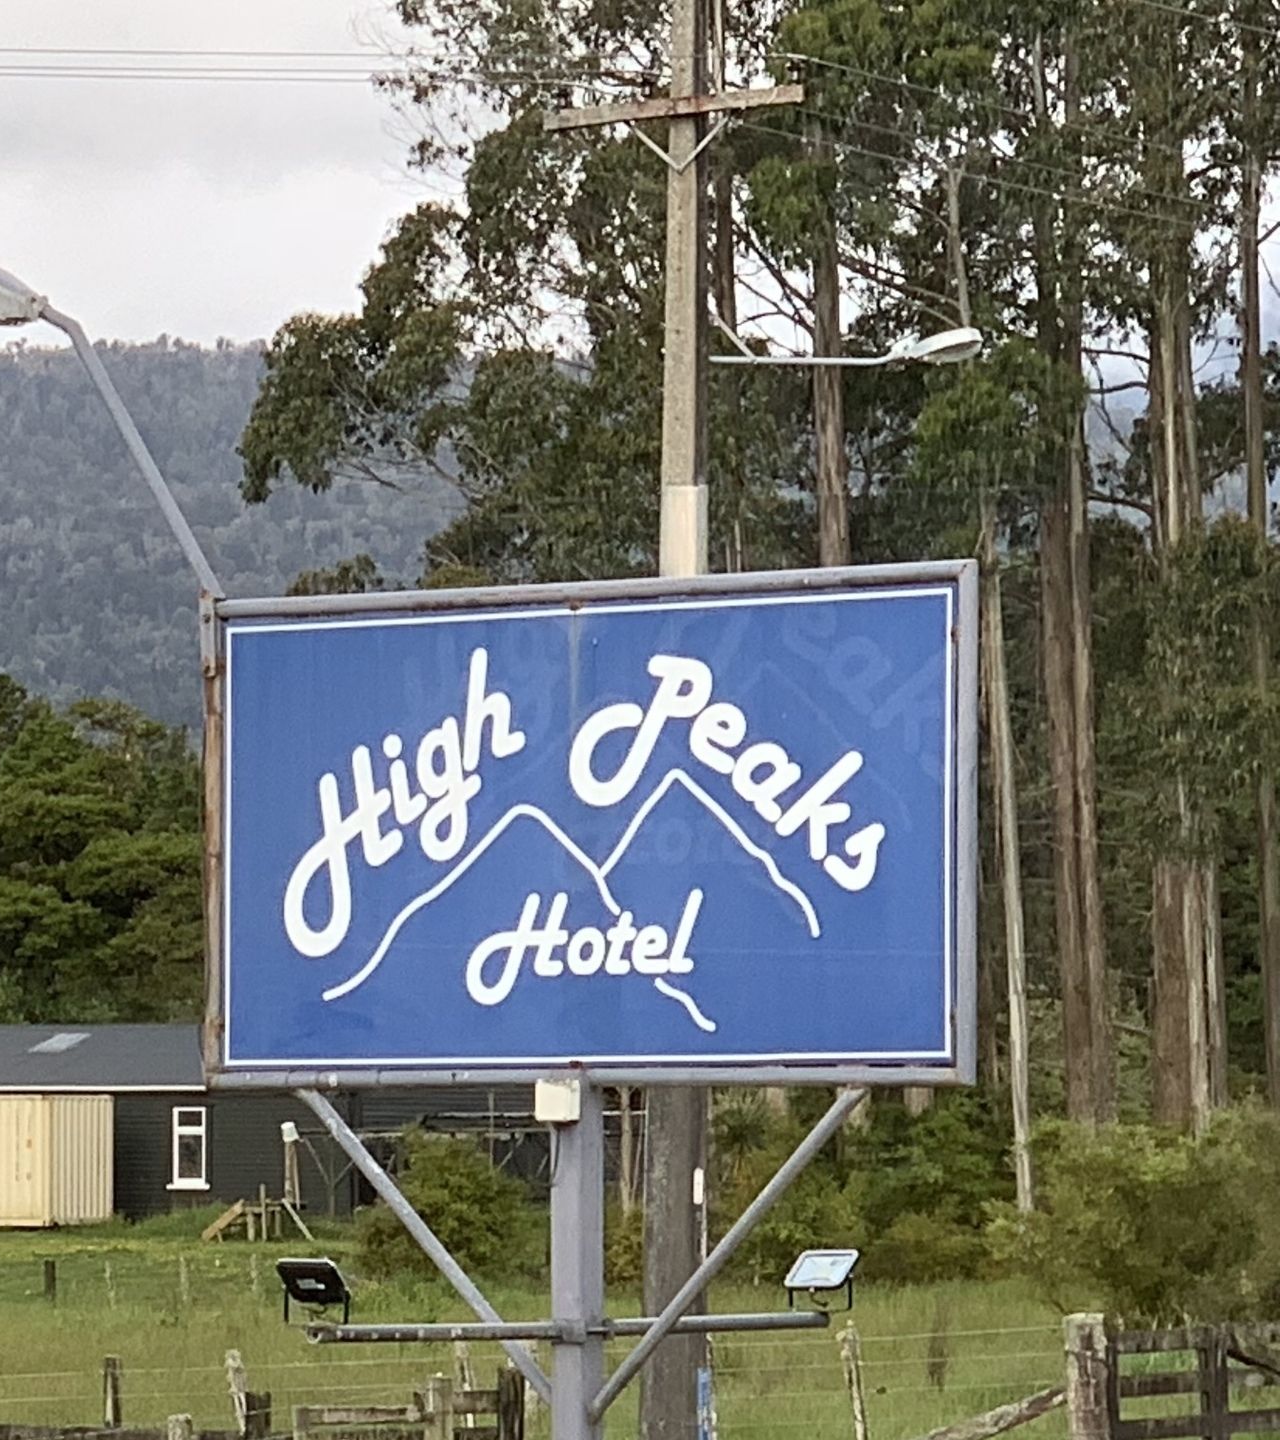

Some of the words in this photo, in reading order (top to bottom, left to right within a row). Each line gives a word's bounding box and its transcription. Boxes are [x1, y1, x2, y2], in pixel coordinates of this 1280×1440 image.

[283, 647, 527, 957] High
[568, 653, 886, 892] Peaks
[465, 888, 703, 1006] Hotel
